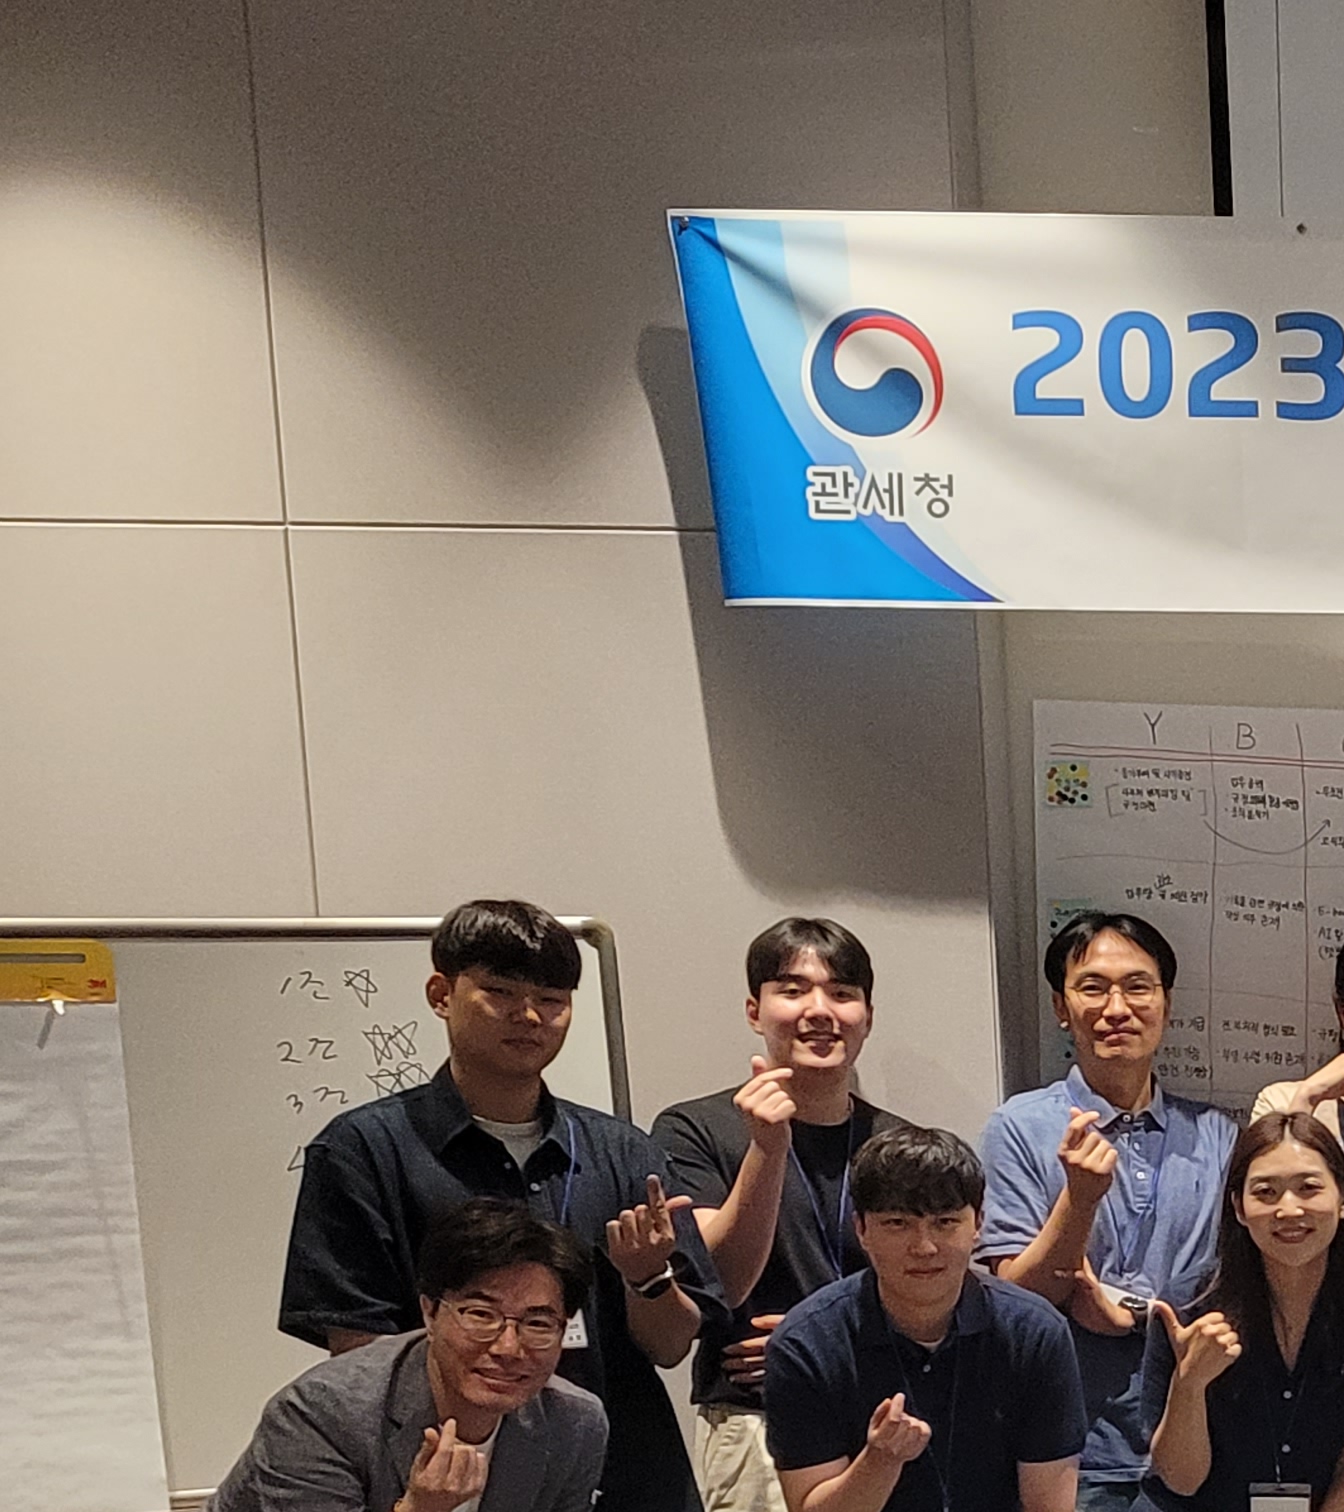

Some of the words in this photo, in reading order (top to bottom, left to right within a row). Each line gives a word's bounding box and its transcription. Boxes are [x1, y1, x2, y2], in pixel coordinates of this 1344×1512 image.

[806, 463, 957, 524] 관세청
[1143, 711, 1164, 745] Y
[1235, 722, 1257, 750] B
[279, 971, 330, 1000] 1조
[276, 1036, 338, 1064] 2조
[286, 1086, 349, 1115] 3조
